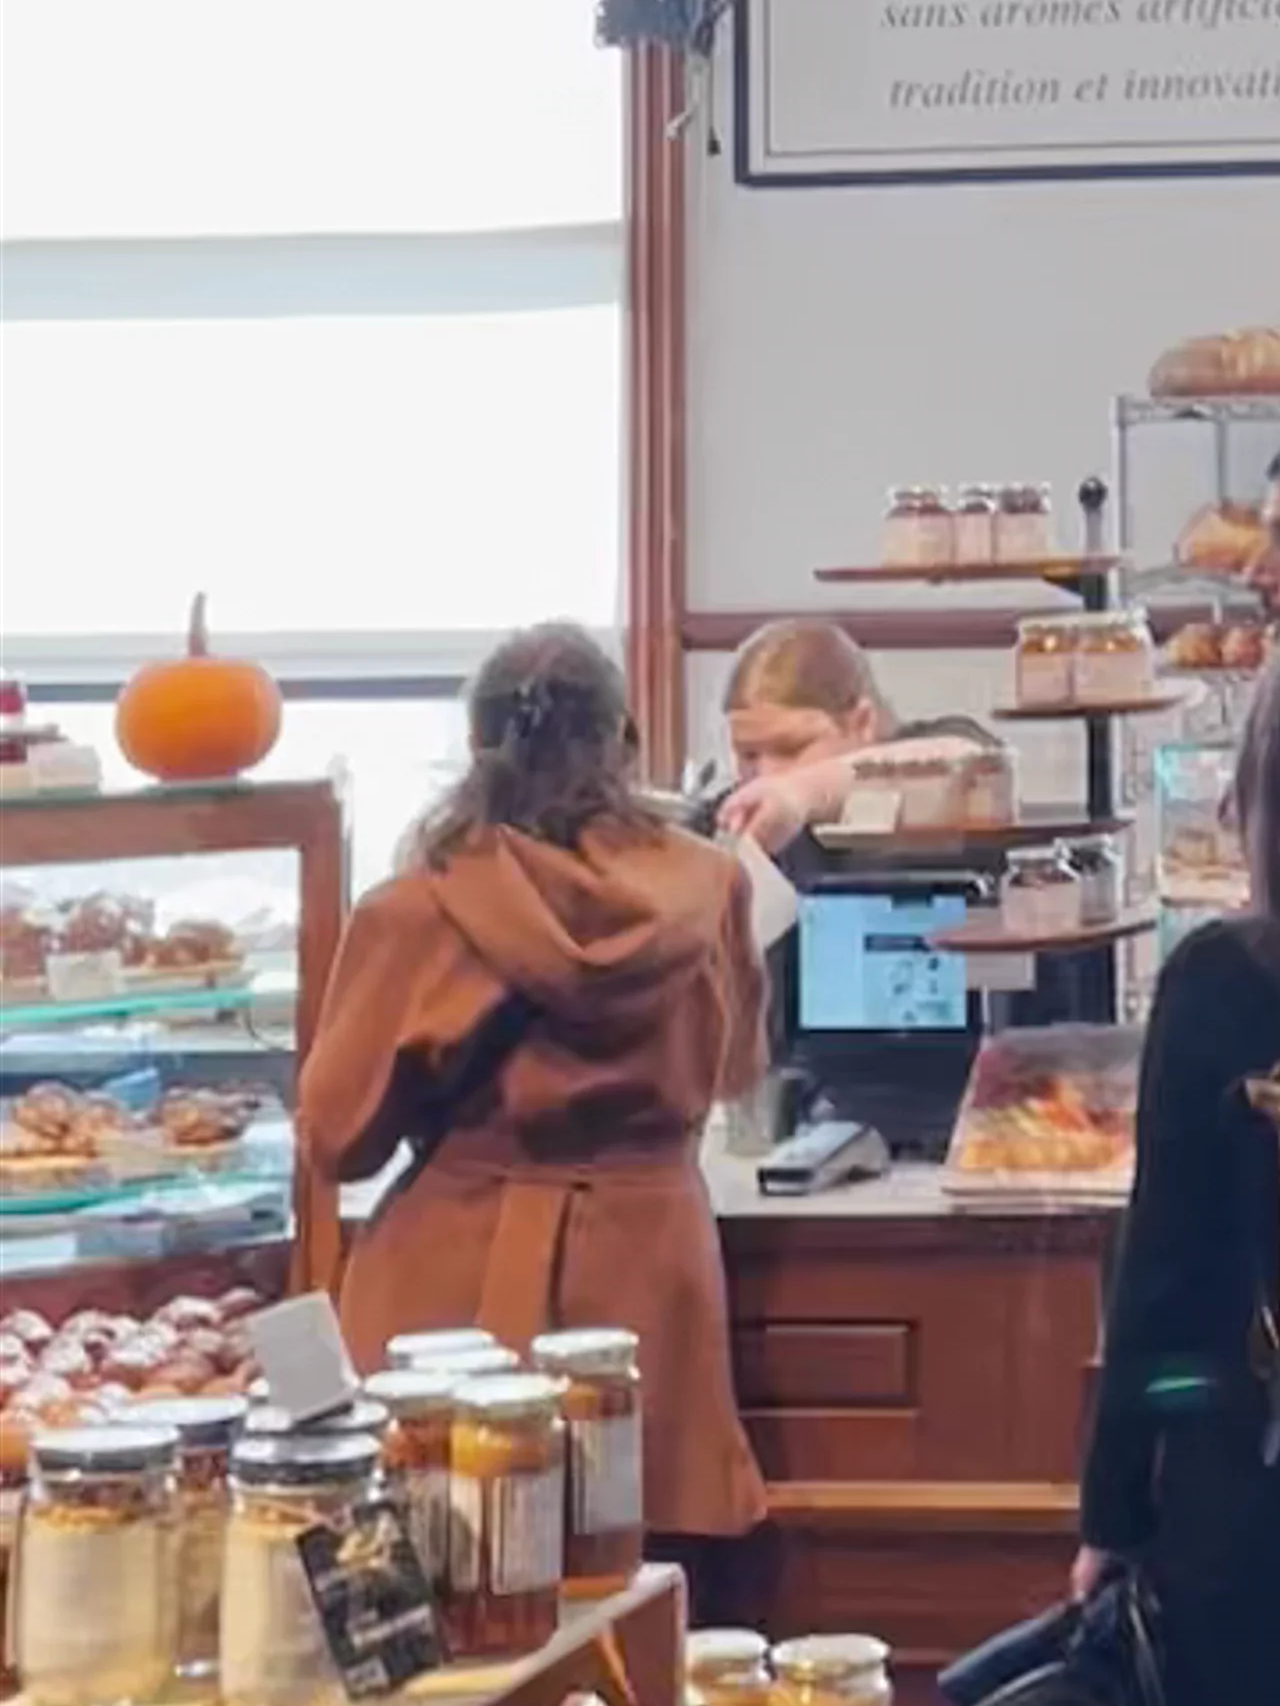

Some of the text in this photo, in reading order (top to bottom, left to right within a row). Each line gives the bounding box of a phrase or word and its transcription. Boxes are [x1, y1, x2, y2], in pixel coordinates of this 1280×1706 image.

[880, 1, 970, 30] sans
[889, 67, 1062, 111] tradition
[1072, 71, 1111, 104] et
